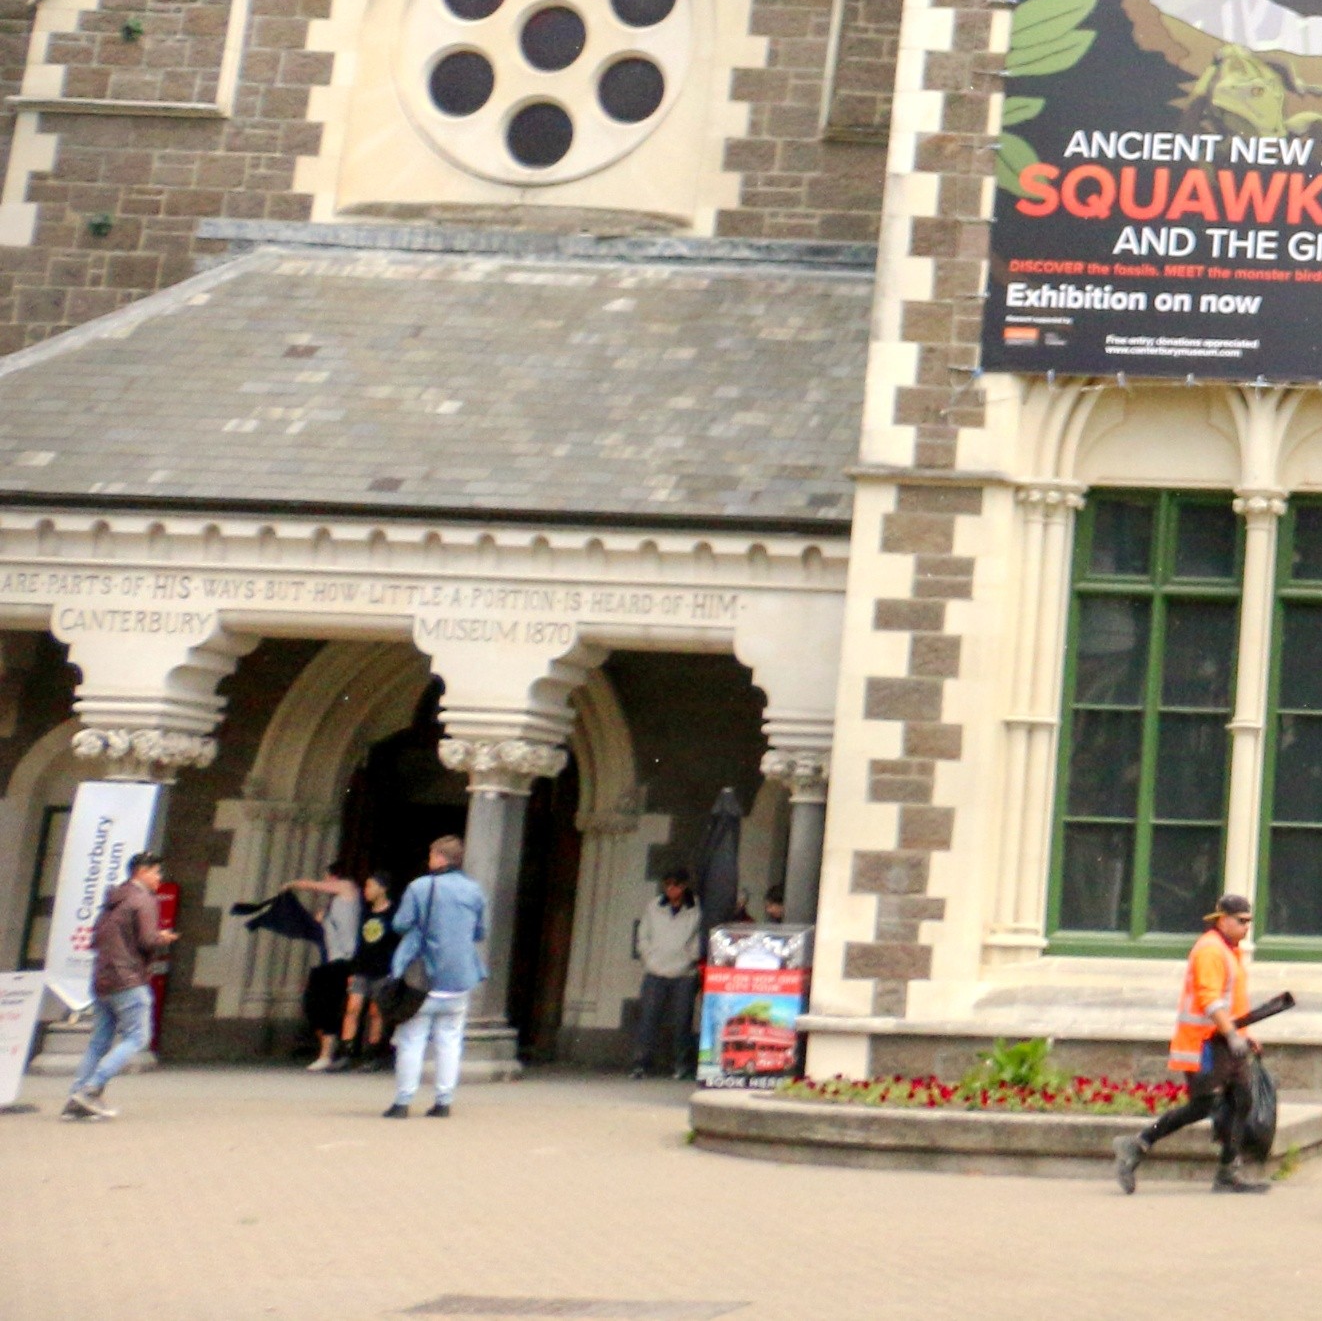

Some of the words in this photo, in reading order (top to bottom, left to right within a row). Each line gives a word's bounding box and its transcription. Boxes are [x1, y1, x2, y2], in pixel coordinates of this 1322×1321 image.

[1063, 129, 1223, 162] ANCIENT
[1231, 135, 1314, 166] NEW
[1112, 225, 1197, 257] AND
[1205, 228, 1279, 260] THE
[1009, 258, 1085, 275] DISCOVER
[1087, 260, 1110, 276] the
[1163, 264, 1206, 278] MEET
[1208, 265, 1232, 280] the
[1234, 268, 1293, 283] monster
[1005, 282, 1148, 311] Exhibition
[1154, 292, 1193, 313] on
[1199, 293, 1262, 315] now
[47, 573, 113, 596] PARTS
[121, 576, 145, 596] OF
[153, 574, 193, 600] HIS
[203, 578, 256, 600] WAYS
[264, 580, 306, 601] BUT
[312, 581, 357, 603] HOW
[368, 582, 442, 606] LITTLE
[449, 586, 461, 606] A
[470, 586, 554, 610] PORTION
[564, 590, 581, 611] IS
[590, 591, 653, 614] HEARD
[661, 593, 684, 615] OF
[690, 592, 740, 620] HIM
[58, 608, 213, 634] CANTERBURY
[419, 617, 518, 642] MUSEUM
[525, 621, 571, 645] 1870
[76, 816, 114, 920] Canterbury
